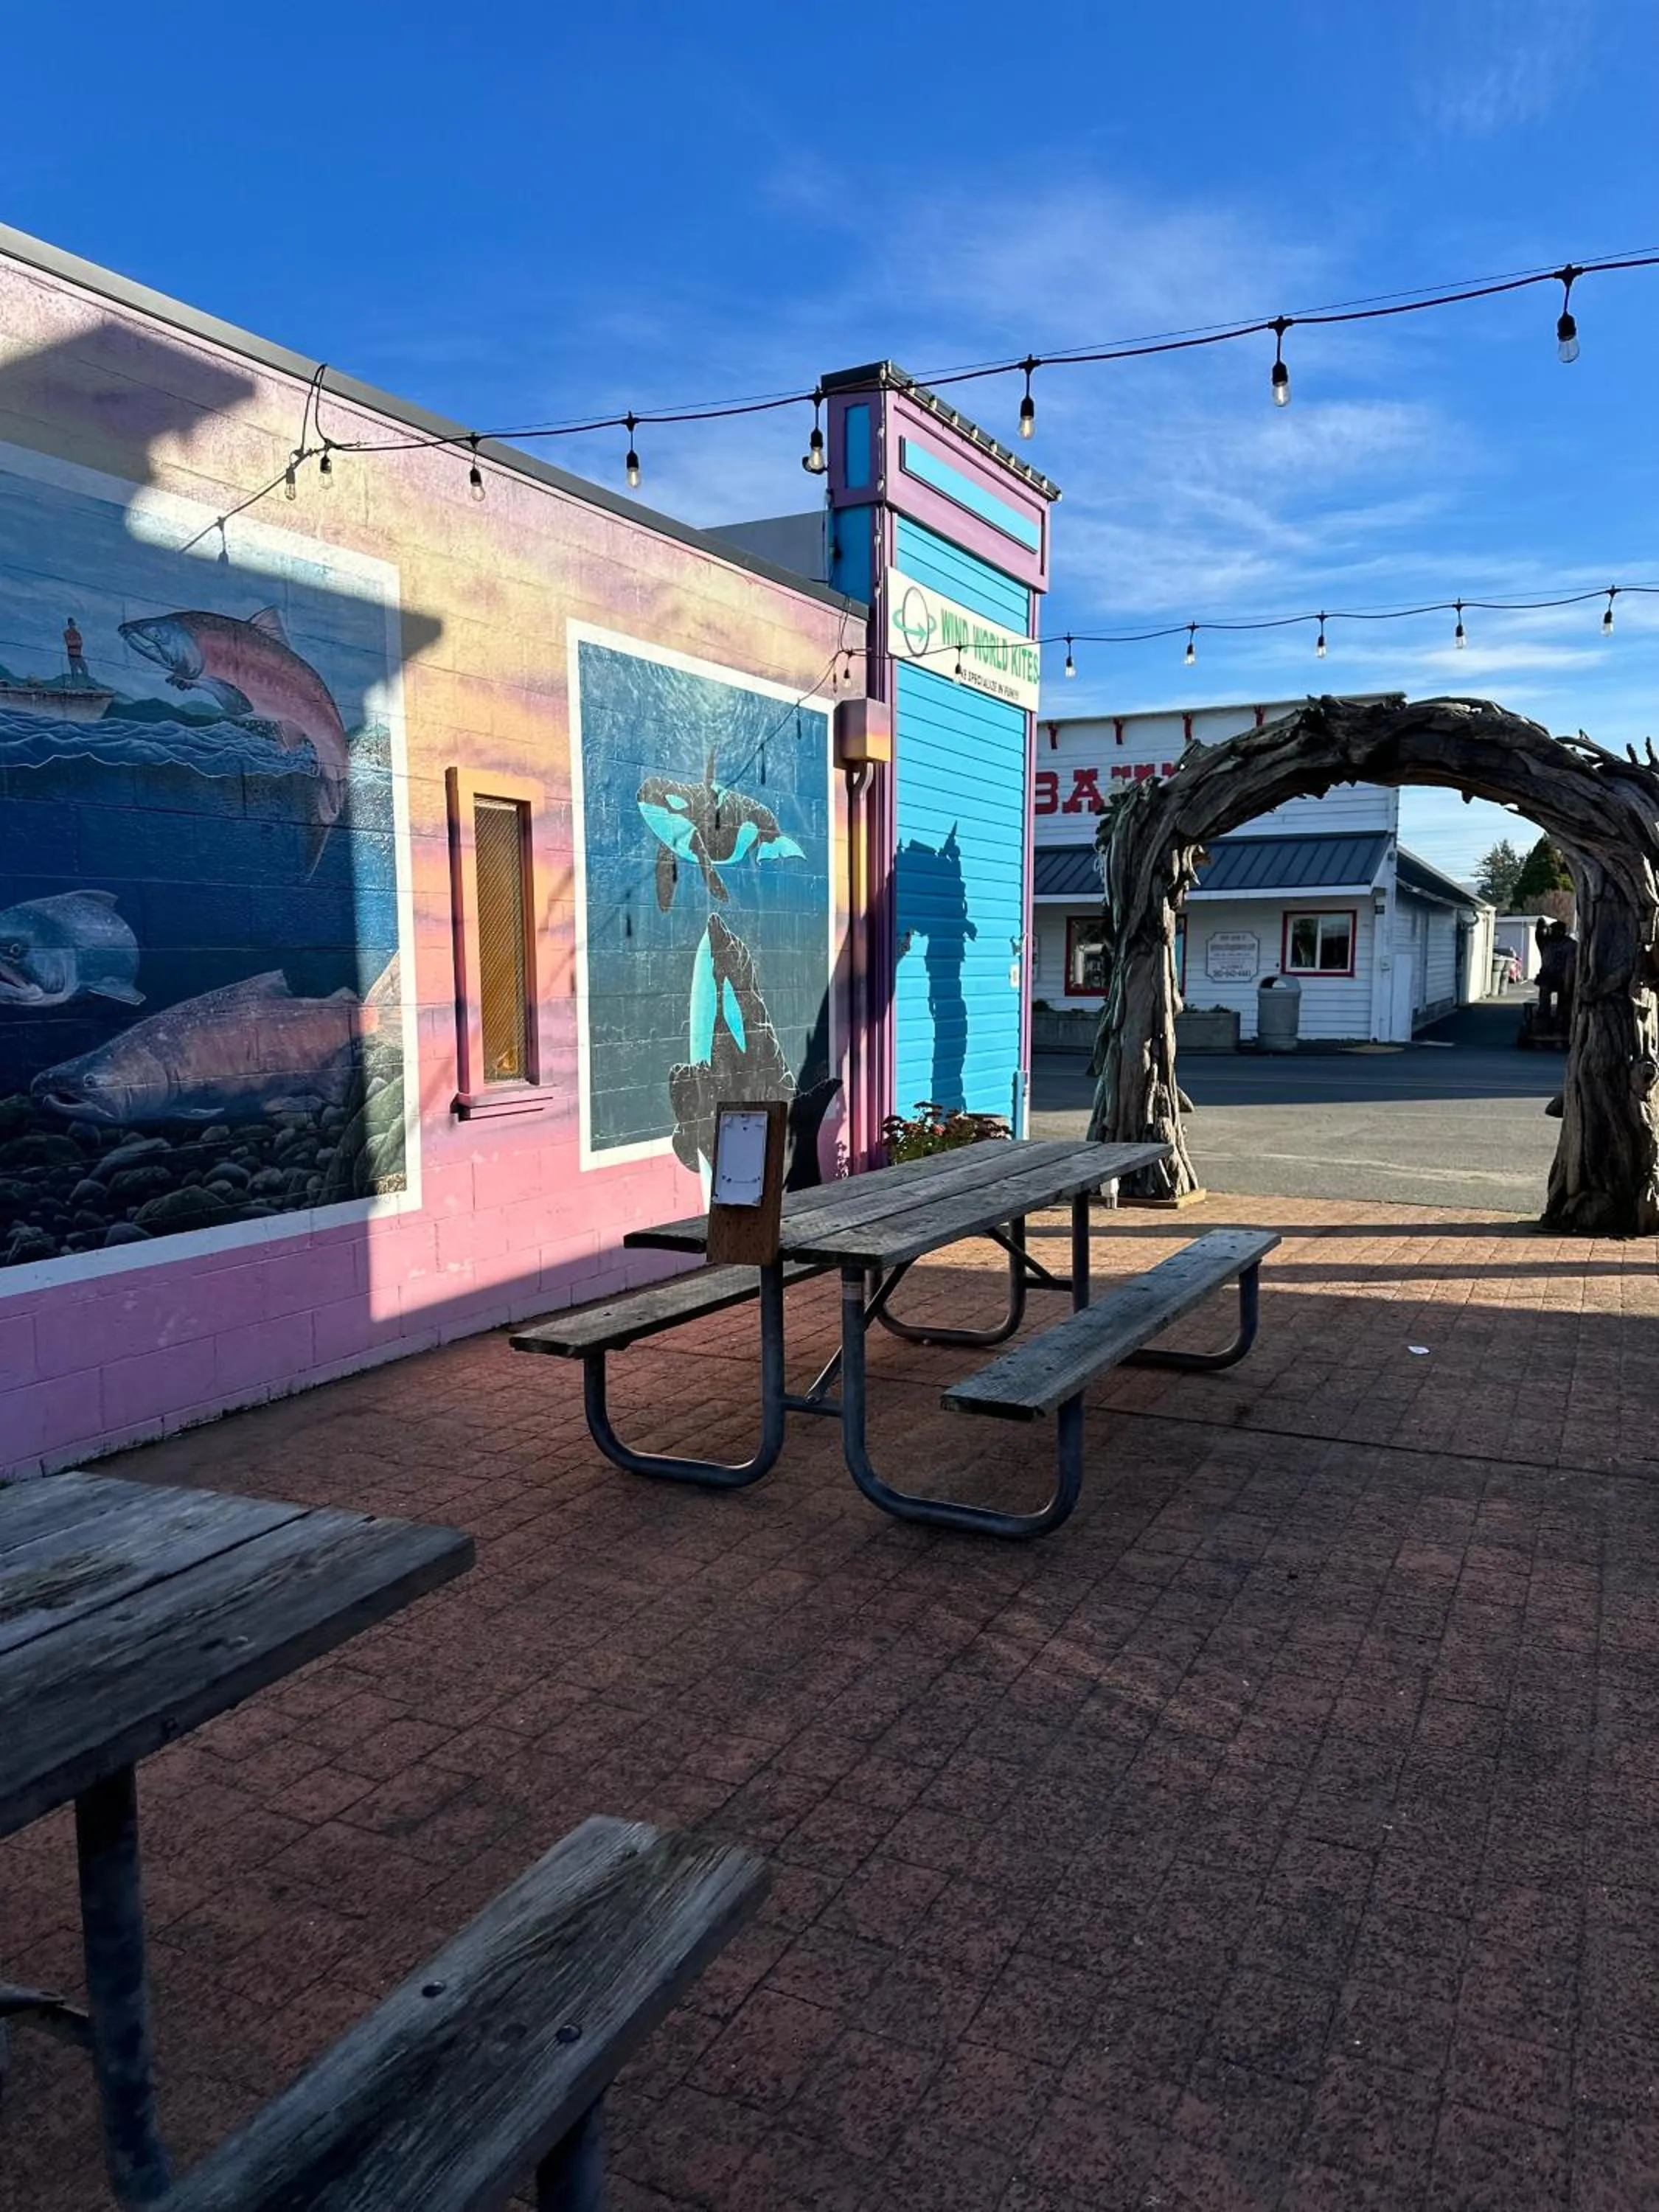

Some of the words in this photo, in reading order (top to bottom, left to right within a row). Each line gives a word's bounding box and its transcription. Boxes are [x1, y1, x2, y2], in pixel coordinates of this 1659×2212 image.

[941, 608, 969, 654] WIND
[973, 624, 1008, 672] WORLD
[1011, 644, 1039, 685] KITES
